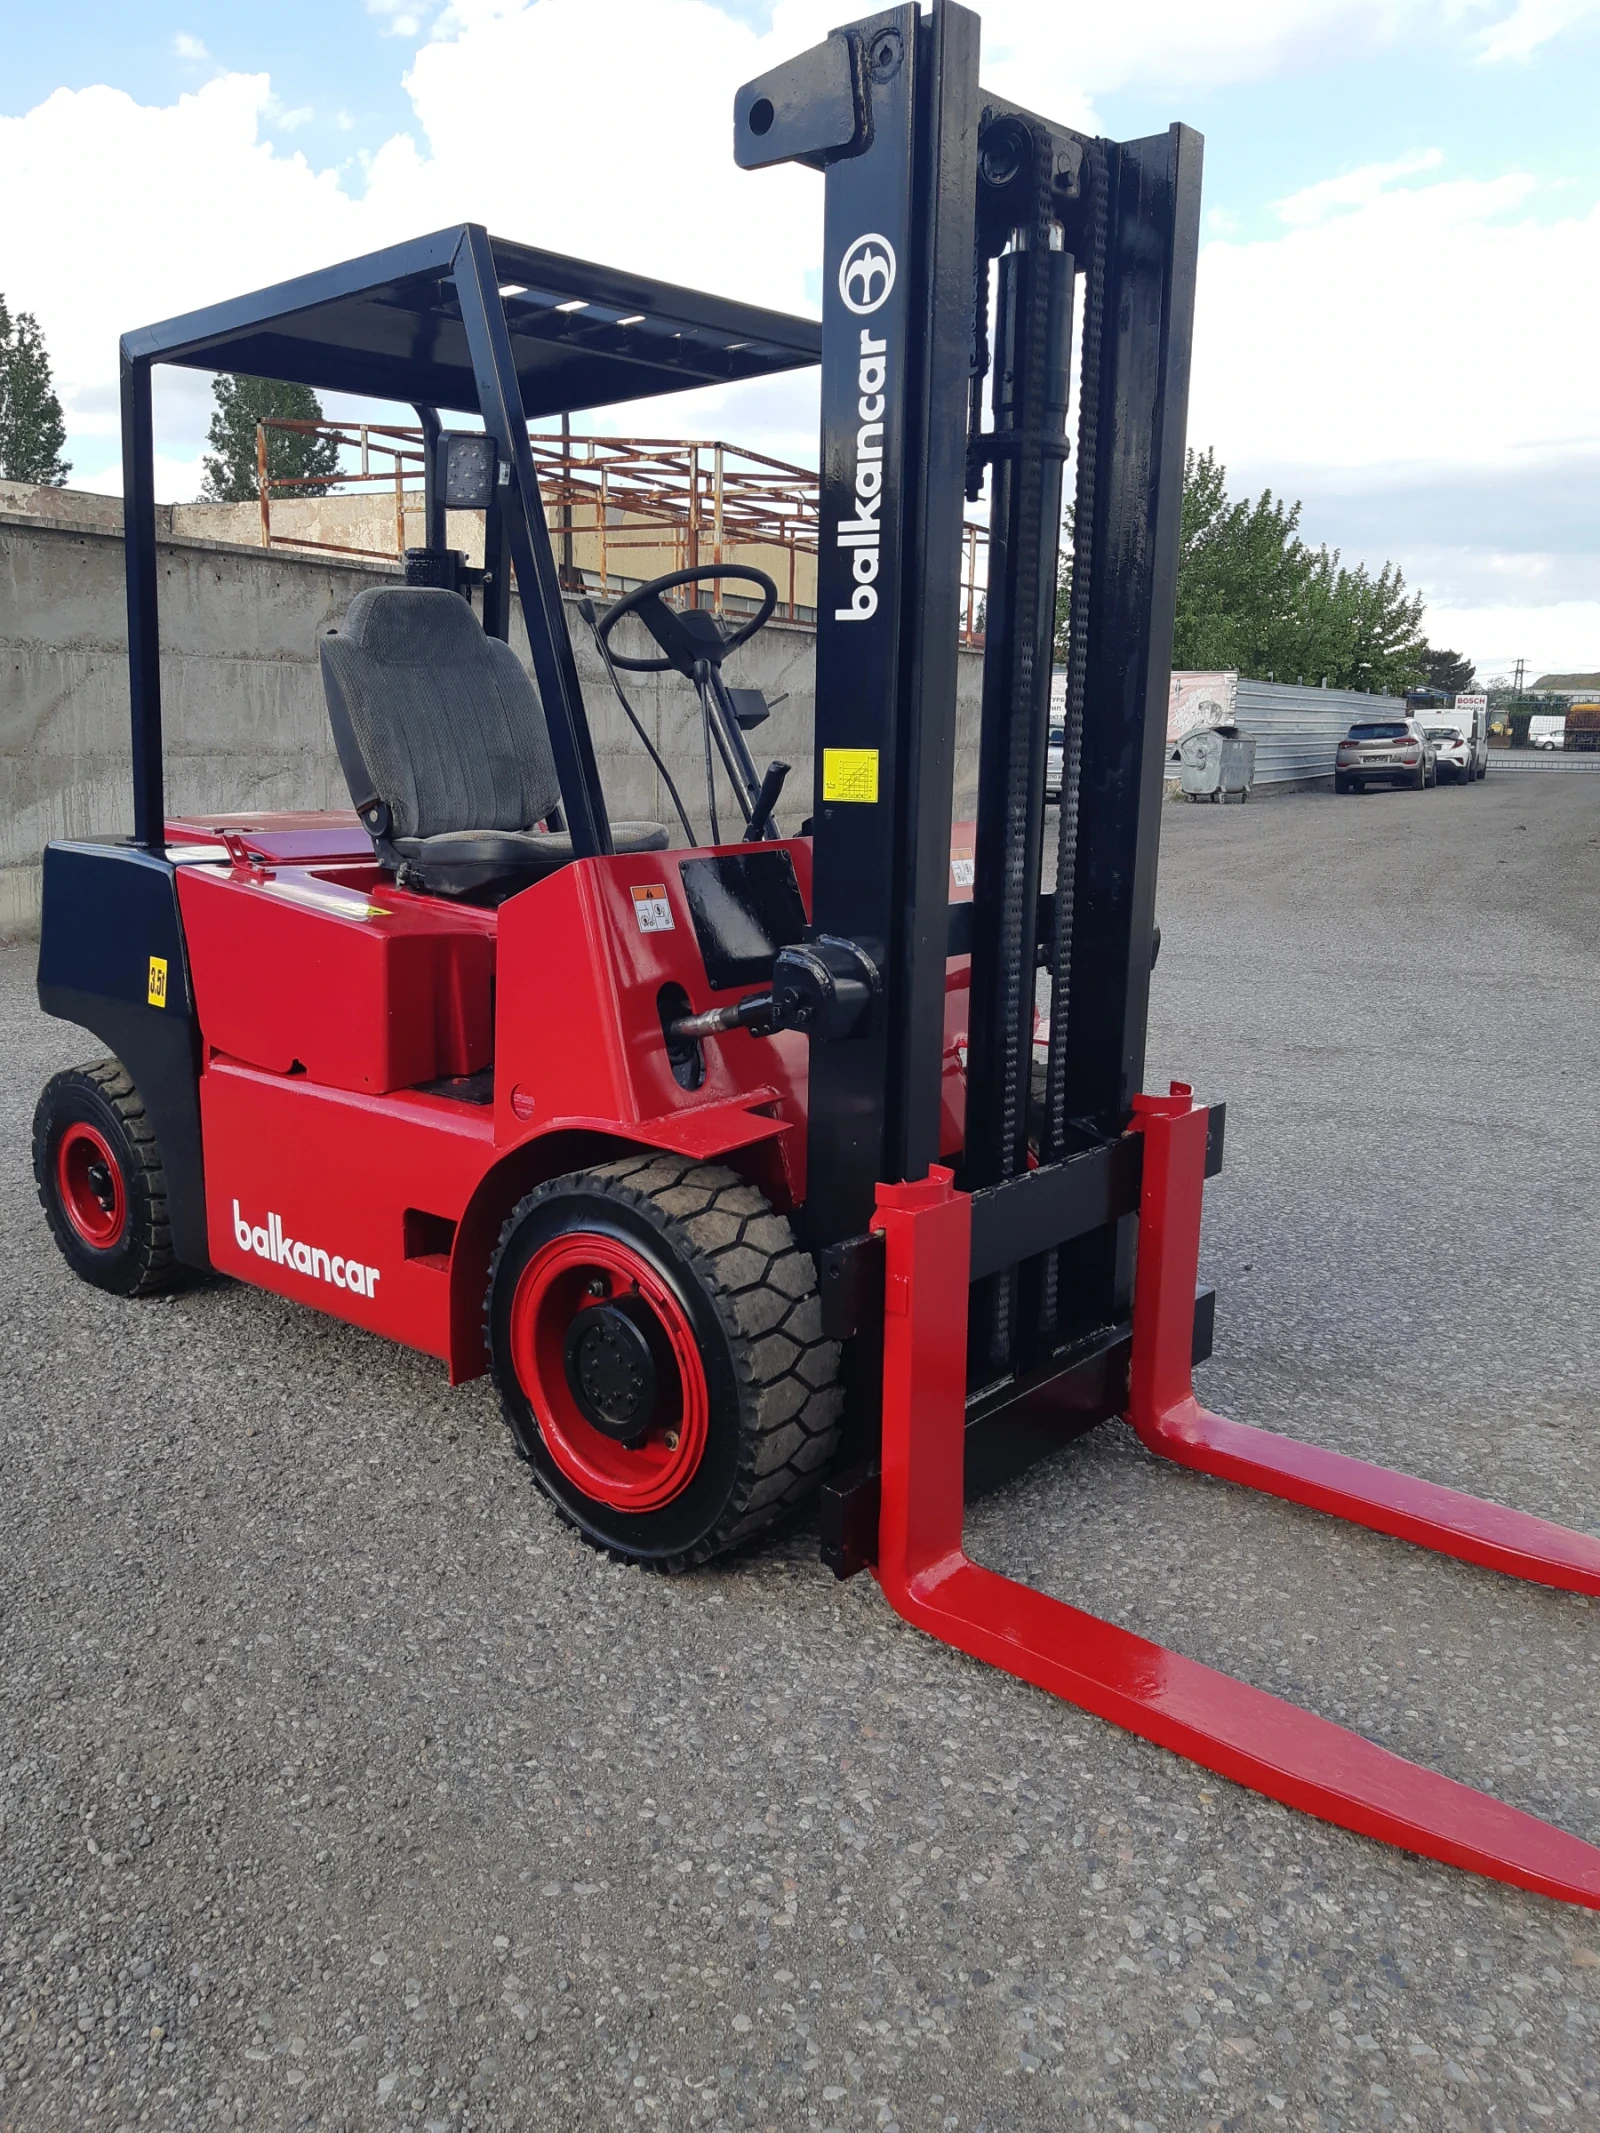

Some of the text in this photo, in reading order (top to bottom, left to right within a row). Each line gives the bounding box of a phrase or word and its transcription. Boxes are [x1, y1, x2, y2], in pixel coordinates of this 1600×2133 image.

[835, 328, 887, 621] balkancar
[150, 966, 165, 997] 3.5t
[233, 1199, 380, 1298] balkancar
